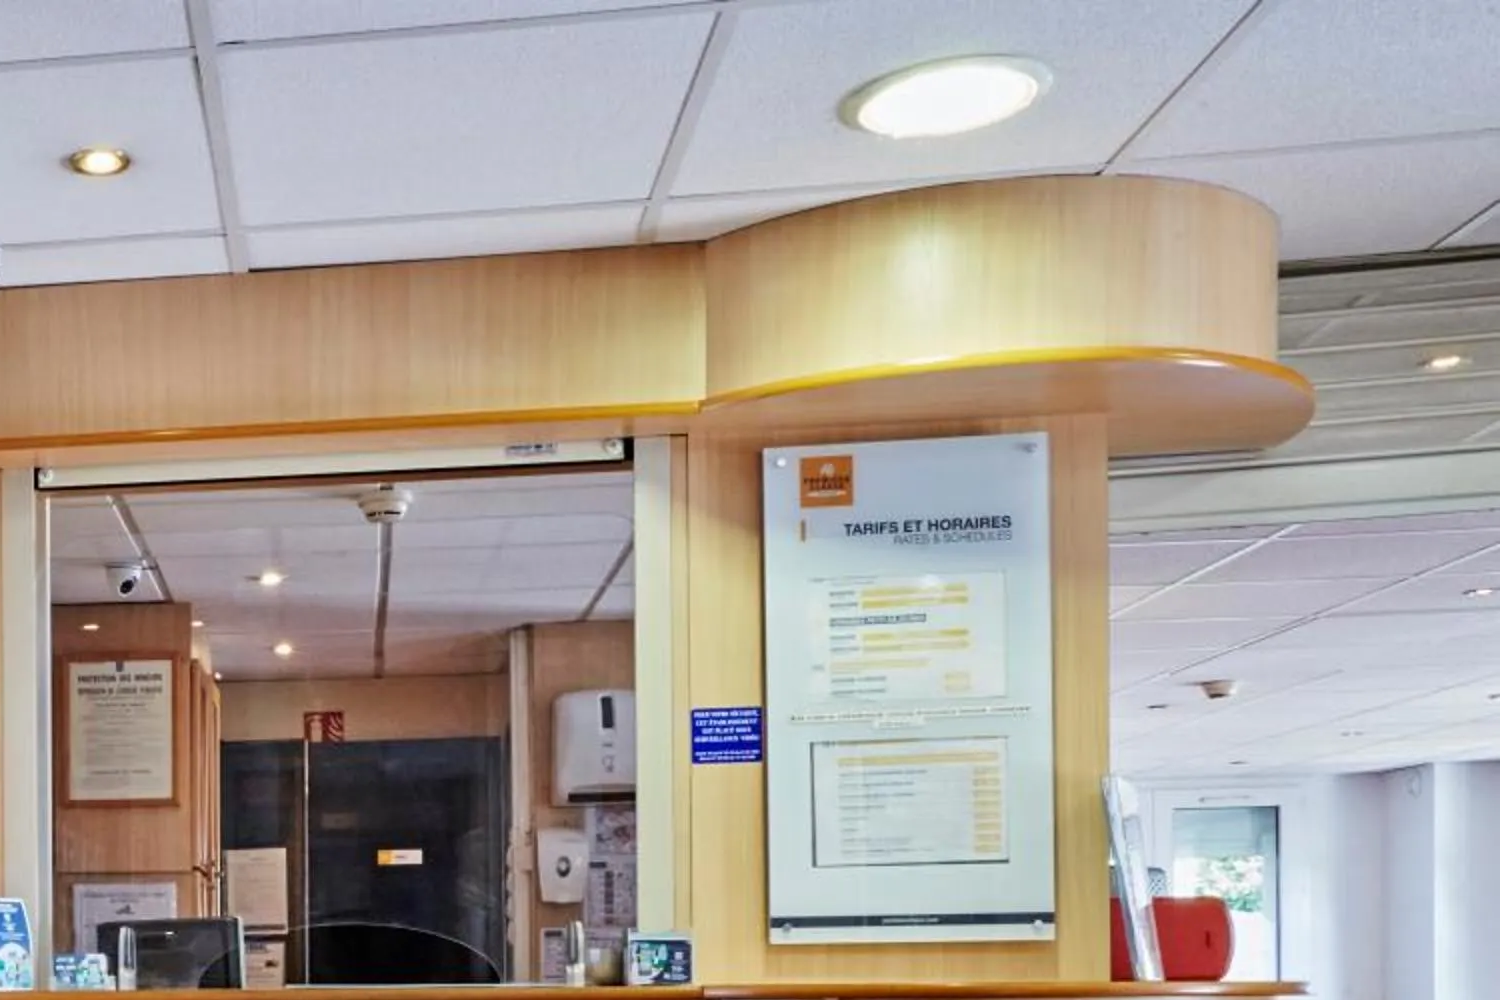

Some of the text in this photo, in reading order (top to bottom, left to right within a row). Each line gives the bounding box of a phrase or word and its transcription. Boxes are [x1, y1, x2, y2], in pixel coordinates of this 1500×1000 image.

[843, 515, 1012, 537] TARIFS ET HORAIRES
